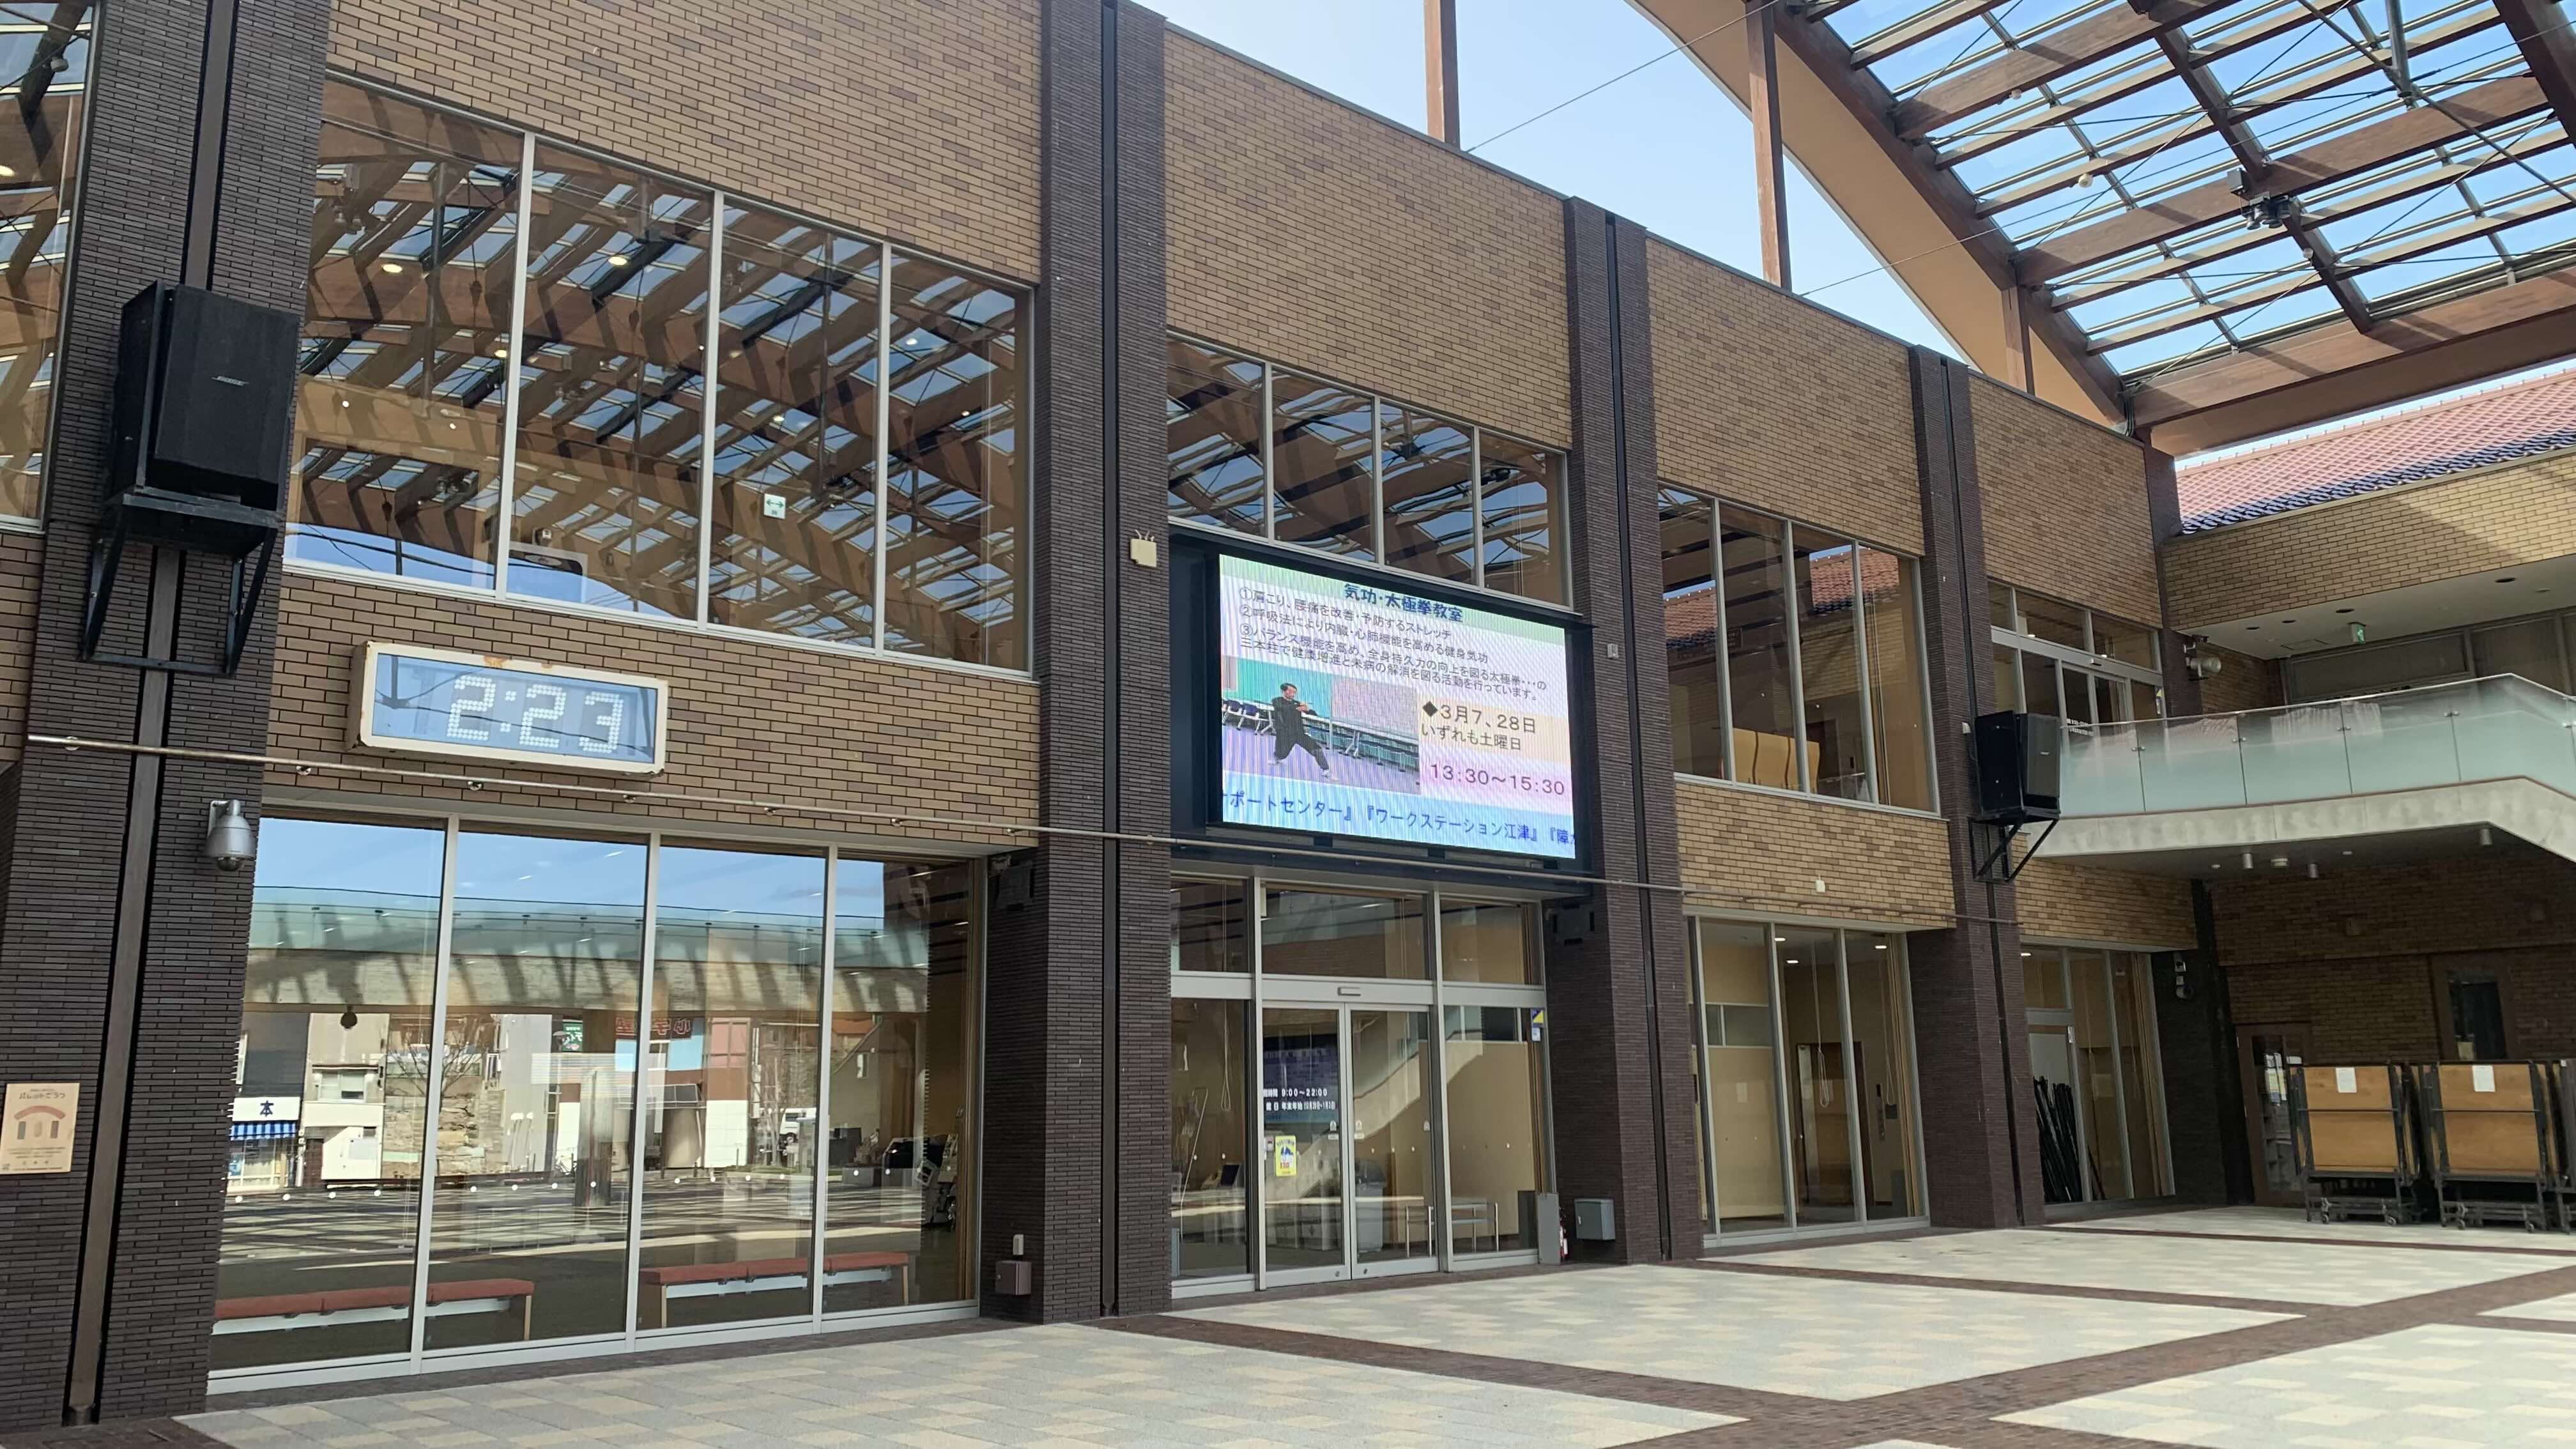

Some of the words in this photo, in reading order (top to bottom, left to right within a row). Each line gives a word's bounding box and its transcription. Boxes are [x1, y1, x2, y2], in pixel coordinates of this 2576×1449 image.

[1344, 583, 1463, 623] 気功・太極拳教室
[447, 675, 624, 754] 2:23
[1422, 723, 1521, 751] いずれも土曜日
